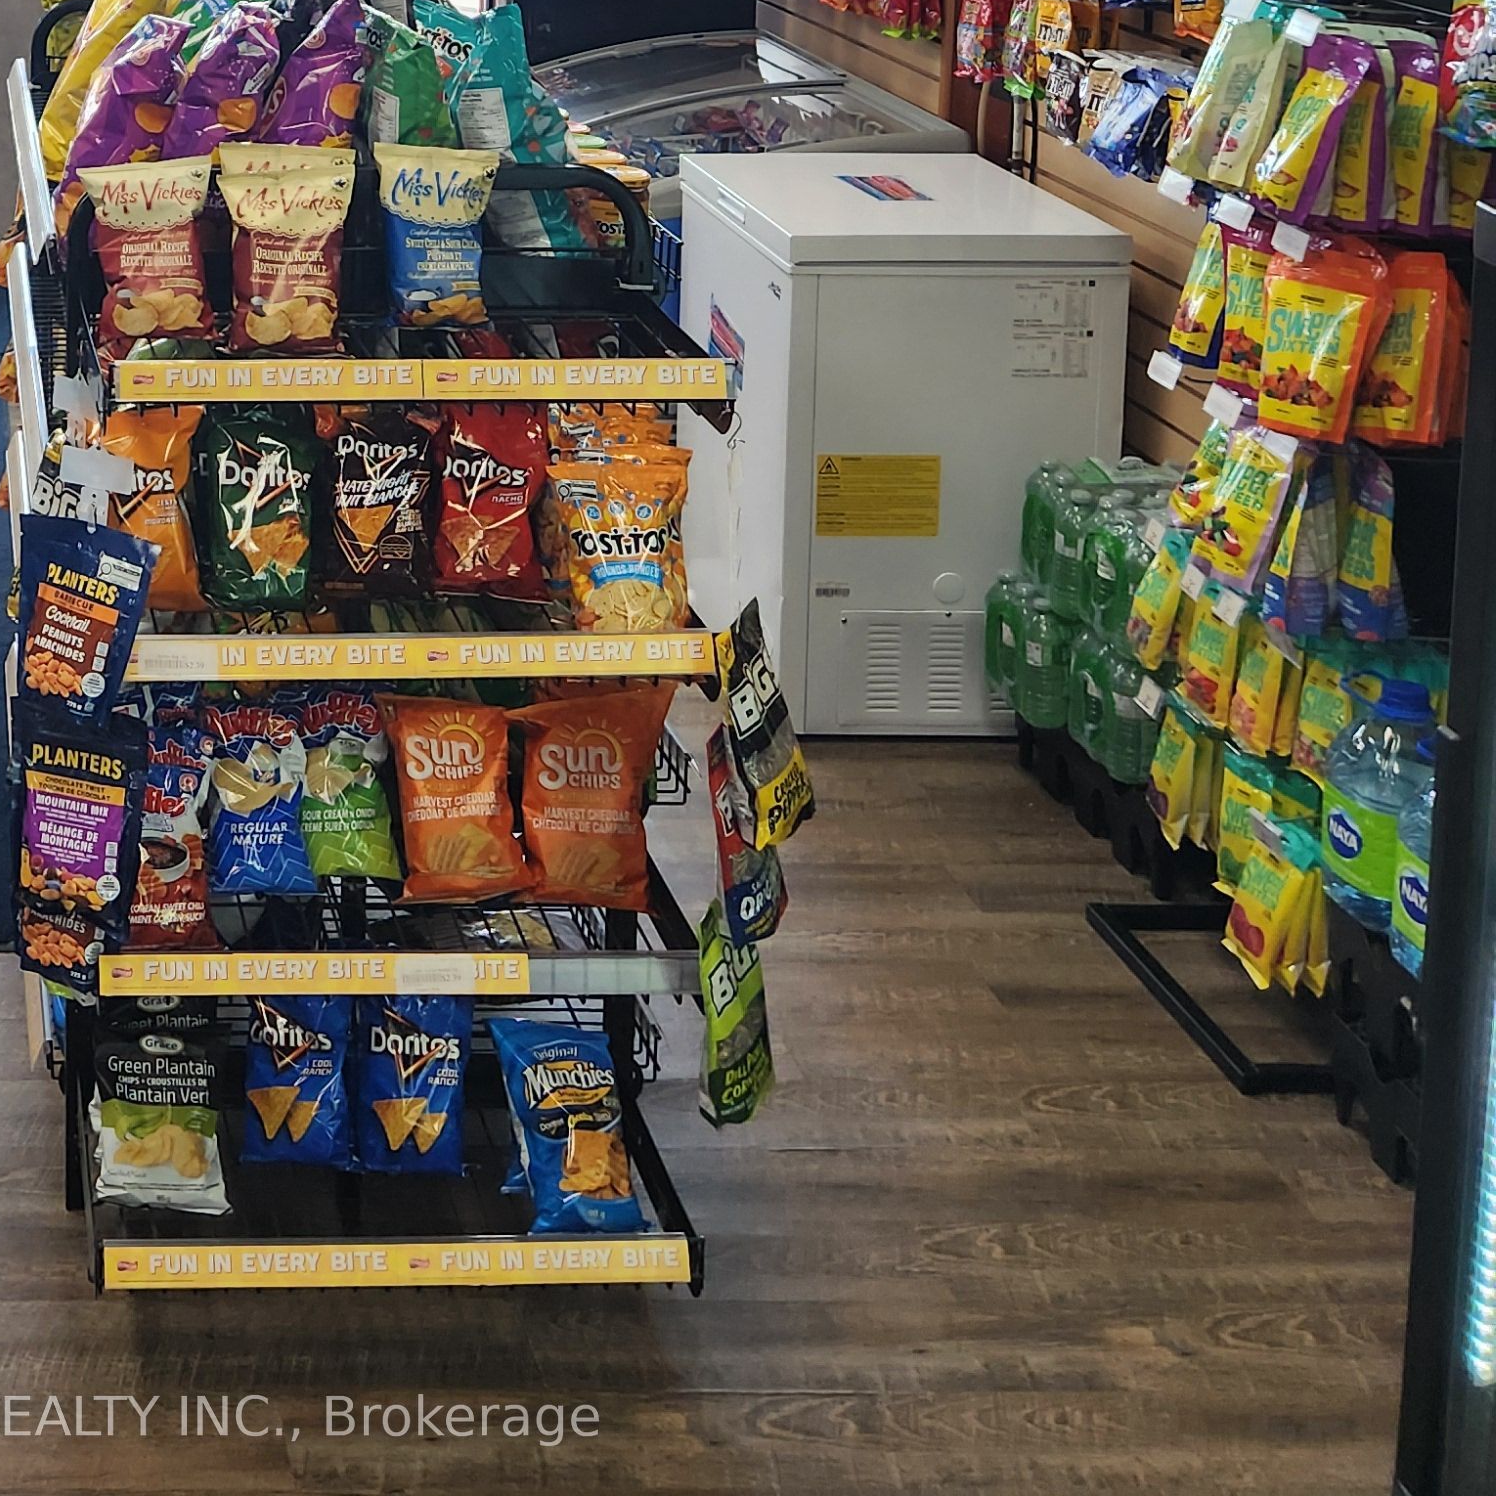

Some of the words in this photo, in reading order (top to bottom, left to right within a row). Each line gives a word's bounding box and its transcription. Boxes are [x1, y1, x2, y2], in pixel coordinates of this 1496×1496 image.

[101, 178, 139, 217] Miss
[139, 177, 202, 212] Vickie's
[392, 167, 433, 206] Miss
[280, 185, 343, 218] Vickie's
[122, 242, 159, 253] ORIGINAL
[160, 241, 190, 253] RECIPE
[294, 250, 324, 262] RECIPE
[165, 366, 217, 388] FUN
[226, 367, 252, 387] IN
[261, 366, 342, 387] EVERY
[353, 366, 413, 385] BITE
[469, 366, 521, 386] FUN
[531, 366, 555, 385] IN
[564, 365, 646, 385] EVERY
[657, 364, 717, 384] BITE
[338, 435, 419, 459] Doritos
[492, 494, 524, 504] NACHO
[570, 526, 669, 558] TOSTITOS
[47, 562, 118, 606] PLANTERS
[45, 605, 91, 635] Cocktail
[41, 623, 85, 649] PEANUTS
[33, 634, 86, 664] ARACHIDES
[221, 646, 246, 665] IN
[256, 645, 336, 666] EVERY
[347, 645, 407, 664] BITE
[459, 643, 515, 664] FUN
[520, 643, 545, 663] IN
[551, 641, 634, 662] EVERY
[647, 639, 706, 660] BITE
[32, 743, 122, 780] PLANTERS
[405, 734, 486, 781] Sun
[537, 743, 623, 791] Sun
[434, 762, 484, 780] CHIPS
[568, 774, 622, 790] CHIPS
[35, 793, 88, 814] MOUNTAIN
[90, 805, 109, 817] MIX
[413, 795, 452, 809] HARVEST
[454, 791, 497, 806] CHEDDAR
[323, 809, 348, 819] CREAM
[408, 808, 445, 823] CHEDDAR
[544, 806, 587, 820] HARVEST
[39, 821, 84, 840] MÉLANGE
[86, 831, 99, 843] DE
[230, 821, 288, 832] REGULAR
[1328, 820, 1359, 852] NAYA
[40, 832, 94, 854] MONTAGNE
[231, 834, 285, 846] NATURE
[144, 961, 194, 981] FUN
[204, 960, 229, 980] IN
[237, 959, 318, 980] EVERY
[327, 958, 386, 979] BITE
[143, 1038, 179, 1051] Grace
[370, 1026, 461, 1060] Doritos
[533, 1045, 578, 1062] Original
[107, 1055, 152, 1076] Green
[154, 1058, 216, 1078] Plantain
[302, 1067, 333, 1075] RANCH
[312, 1059, 333, 1068] COOL
[435, 1067, 460, 1077] COOL
[117, 1075, 140, 1086] CHIPS
[146, 1076, 197, 1087] CROUSTILLES
[427, 1077, 459, 1086] RANCH
[524, 1061, 615, 1110] Munchies
[116, 1086, 177, 1104] Plantain
[180, 1087, 211, 1105] Vert
[148, 1255, 199, 1275] FUN
[208, 1254, 232, 1274] IN
[241, 1252, 321, 1273] EVERY
[330, 1250, 389, 1272] BITE
[440, 1250, 491, 1272] FUN
[500, 1250, 524, 1270] IN
[533, 1248, 613, 1270] EVERY
[622, 1247, 681, 1268] BITE
